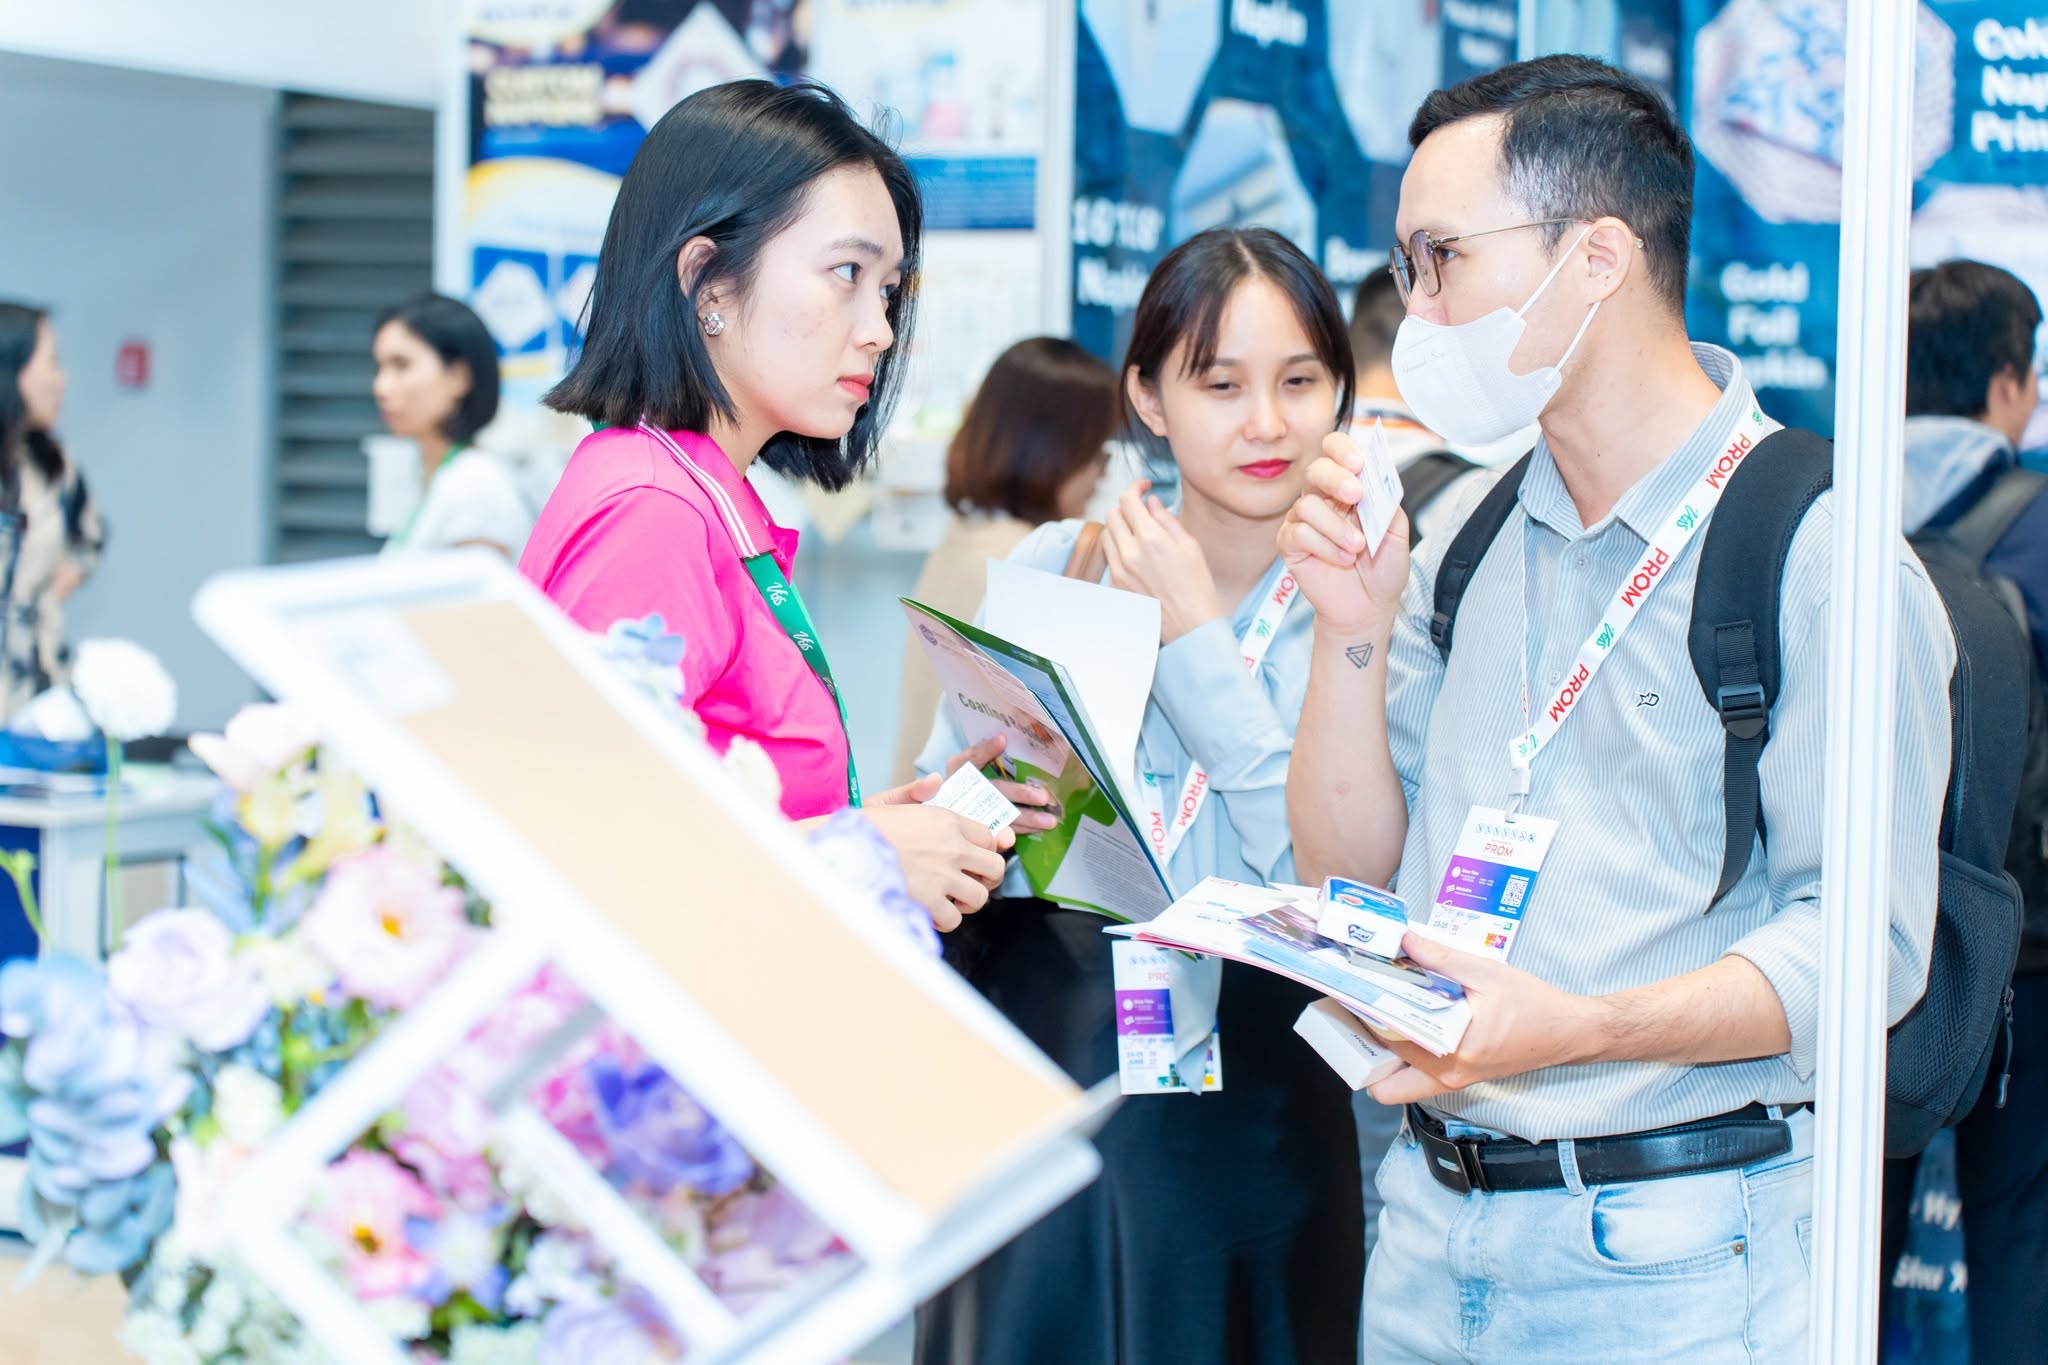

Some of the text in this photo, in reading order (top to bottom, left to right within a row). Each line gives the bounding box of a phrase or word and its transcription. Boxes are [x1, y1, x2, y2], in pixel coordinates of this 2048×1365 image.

[1705, 432, 1752, 490] PROM
[1620, 546, 1670, 608] PROM
[1549, 663, 1589, 722] PROM
[1177, 770, 1208, 827] PROM
[1484, 842, 1515, 858] PROM
[1148, 971, 1170, 982] PRO
